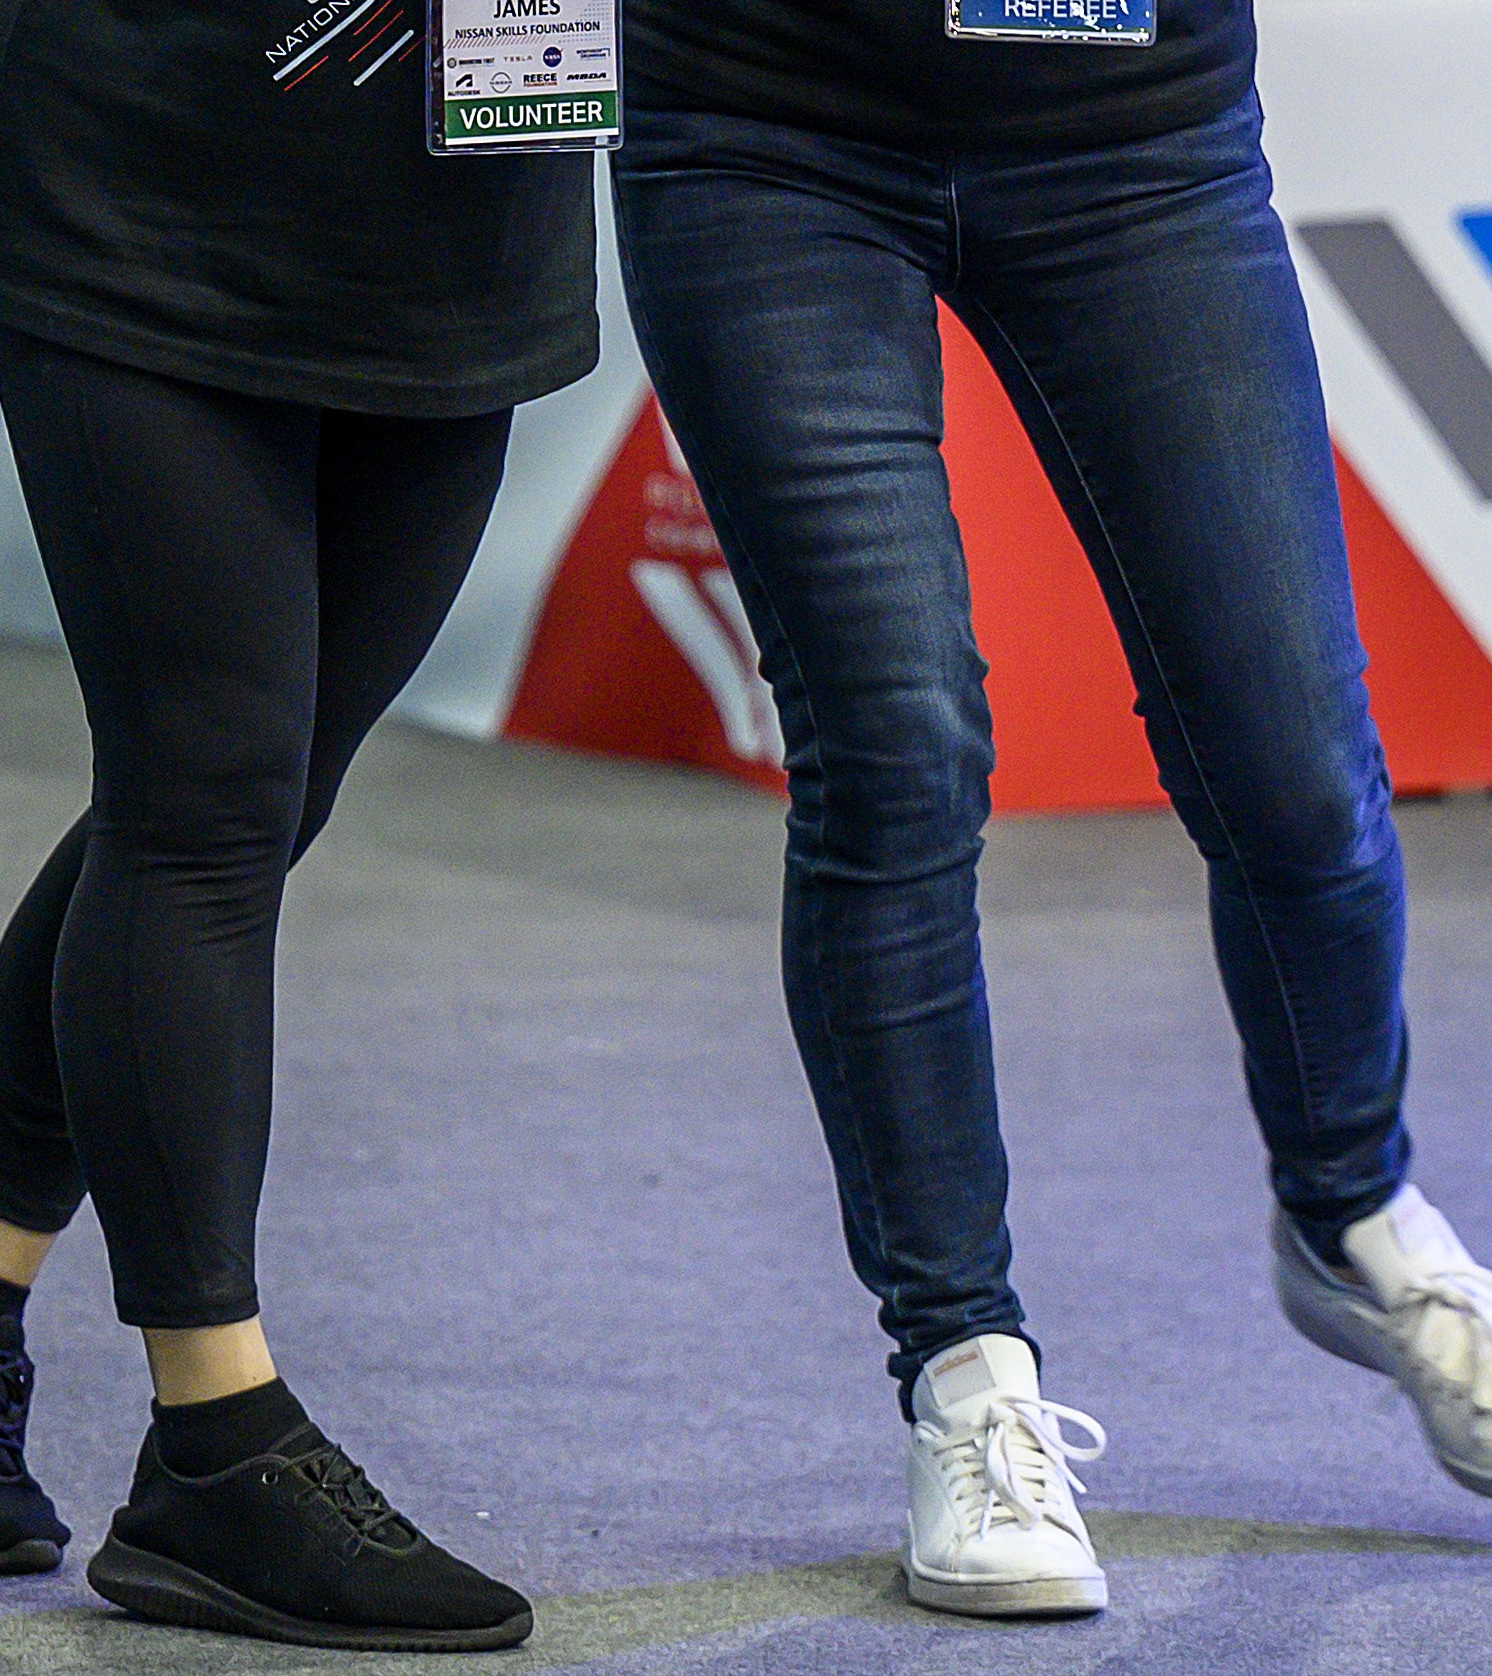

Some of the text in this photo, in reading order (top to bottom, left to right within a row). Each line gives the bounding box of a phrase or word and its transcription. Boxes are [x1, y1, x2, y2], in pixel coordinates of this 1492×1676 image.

[455, 21, 600, 39] NISSAN SKILLS FOUNDATION
[523, 73, 557, 84] REECE
[459, 100, 604, 131] VOLUNTEER
